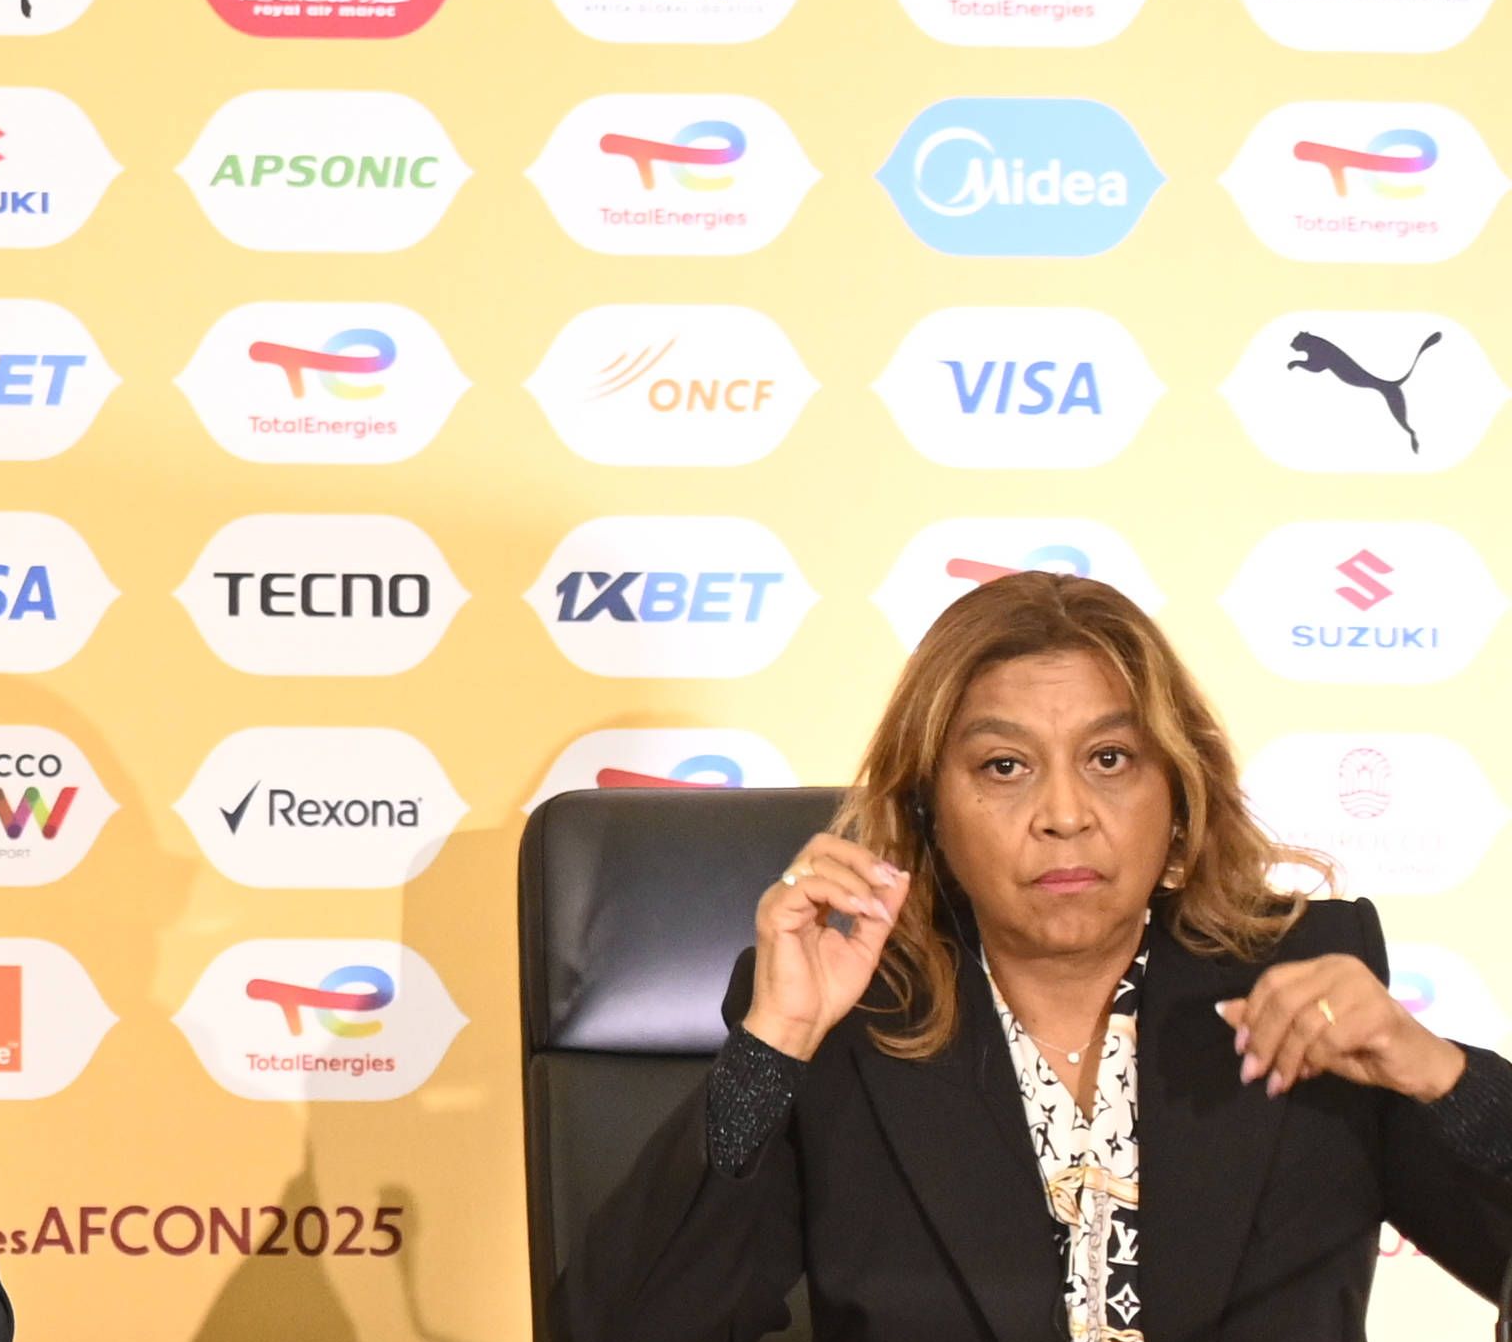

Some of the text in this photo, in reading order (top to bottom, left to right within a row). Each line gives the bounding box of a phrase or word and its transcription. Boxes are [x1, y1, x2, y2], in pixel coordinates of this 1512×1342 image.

[210, 155, 438, 188] APSONIC
[957, 162, 1127, 209] Midea
[648, 379, 774, 412] ONCF
[941, 361, 1101, 415] VISA
[248, 416, 397, 439] TotalEnergies
[214, 573, 429, 617] TECNO
[556, 571, 782, 623] 1XBET
[1292, 626, 1437, 648] SUZUKI
[269, 789, 418, 827] Rexona
